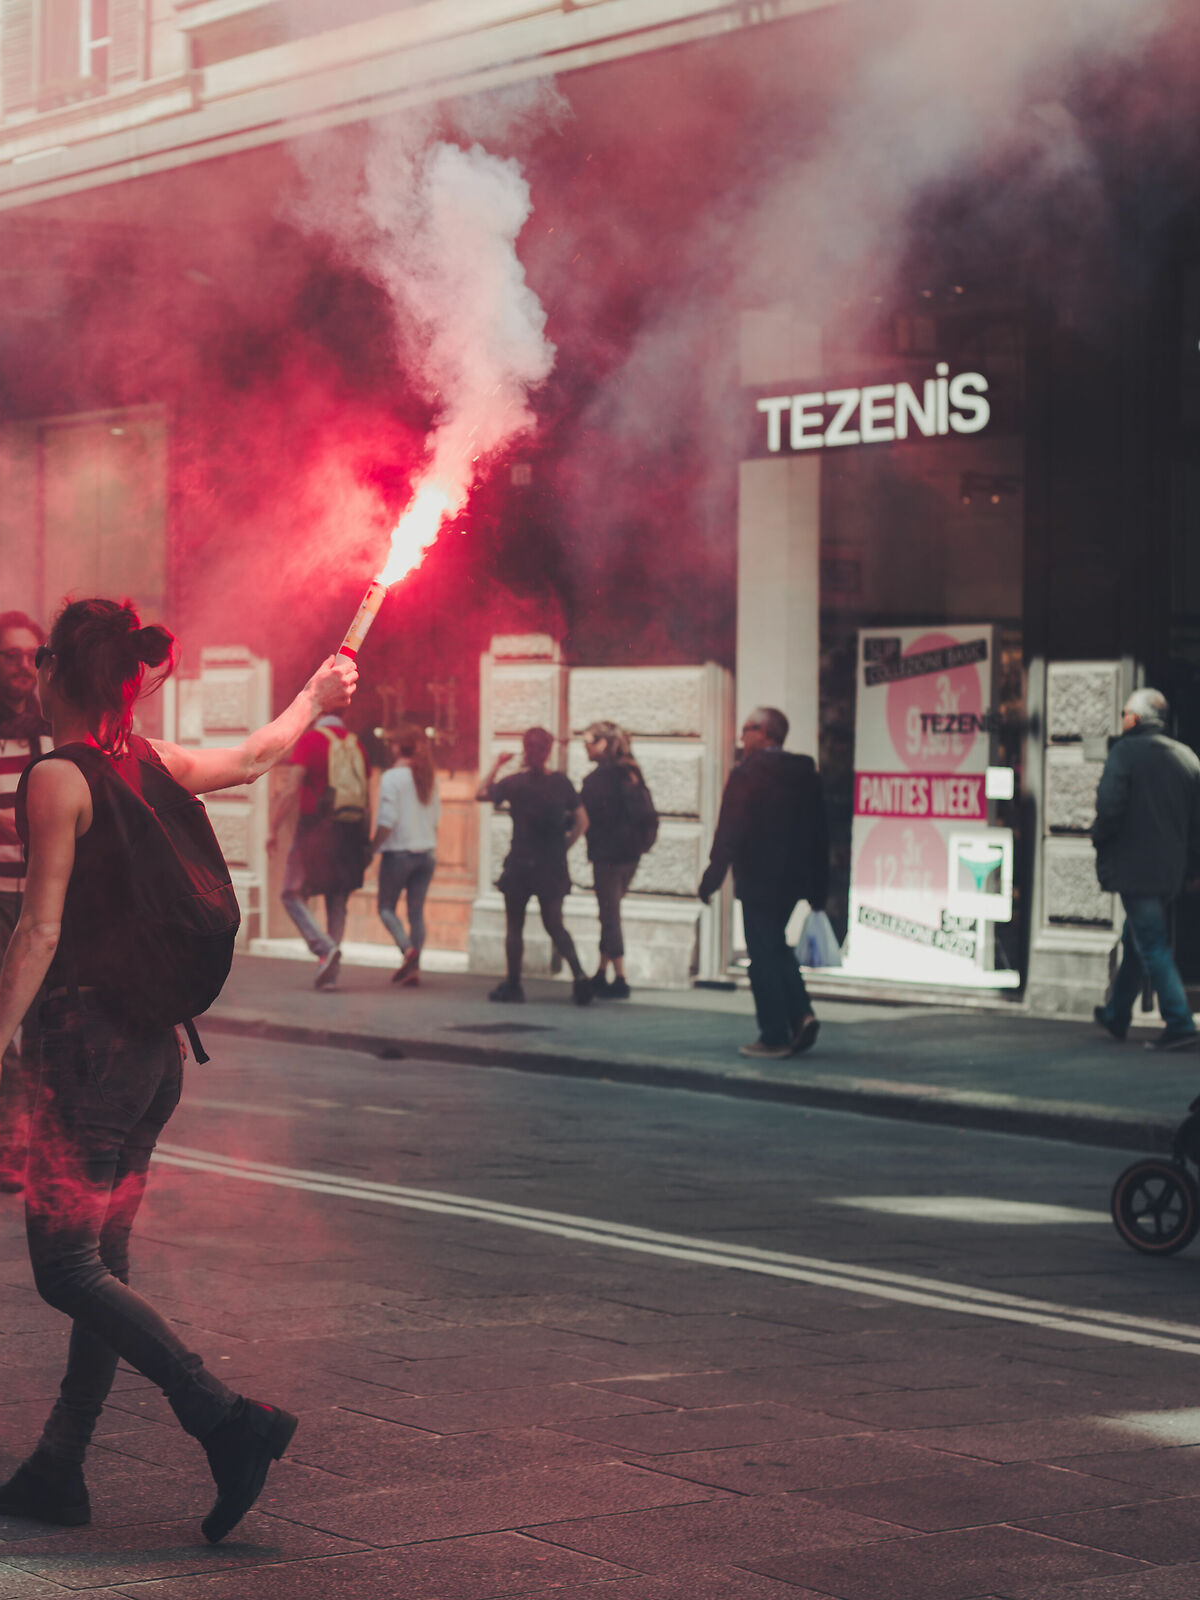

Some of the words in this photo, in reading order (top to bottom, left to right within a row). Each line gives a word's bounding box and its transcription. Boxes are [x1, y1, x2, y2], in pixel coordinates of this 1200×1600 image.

[756, 362, 990, 452] TEZENIS
[859, 775, 929, 815] PANTIES
[931, 777, 982, 816] WEEK
